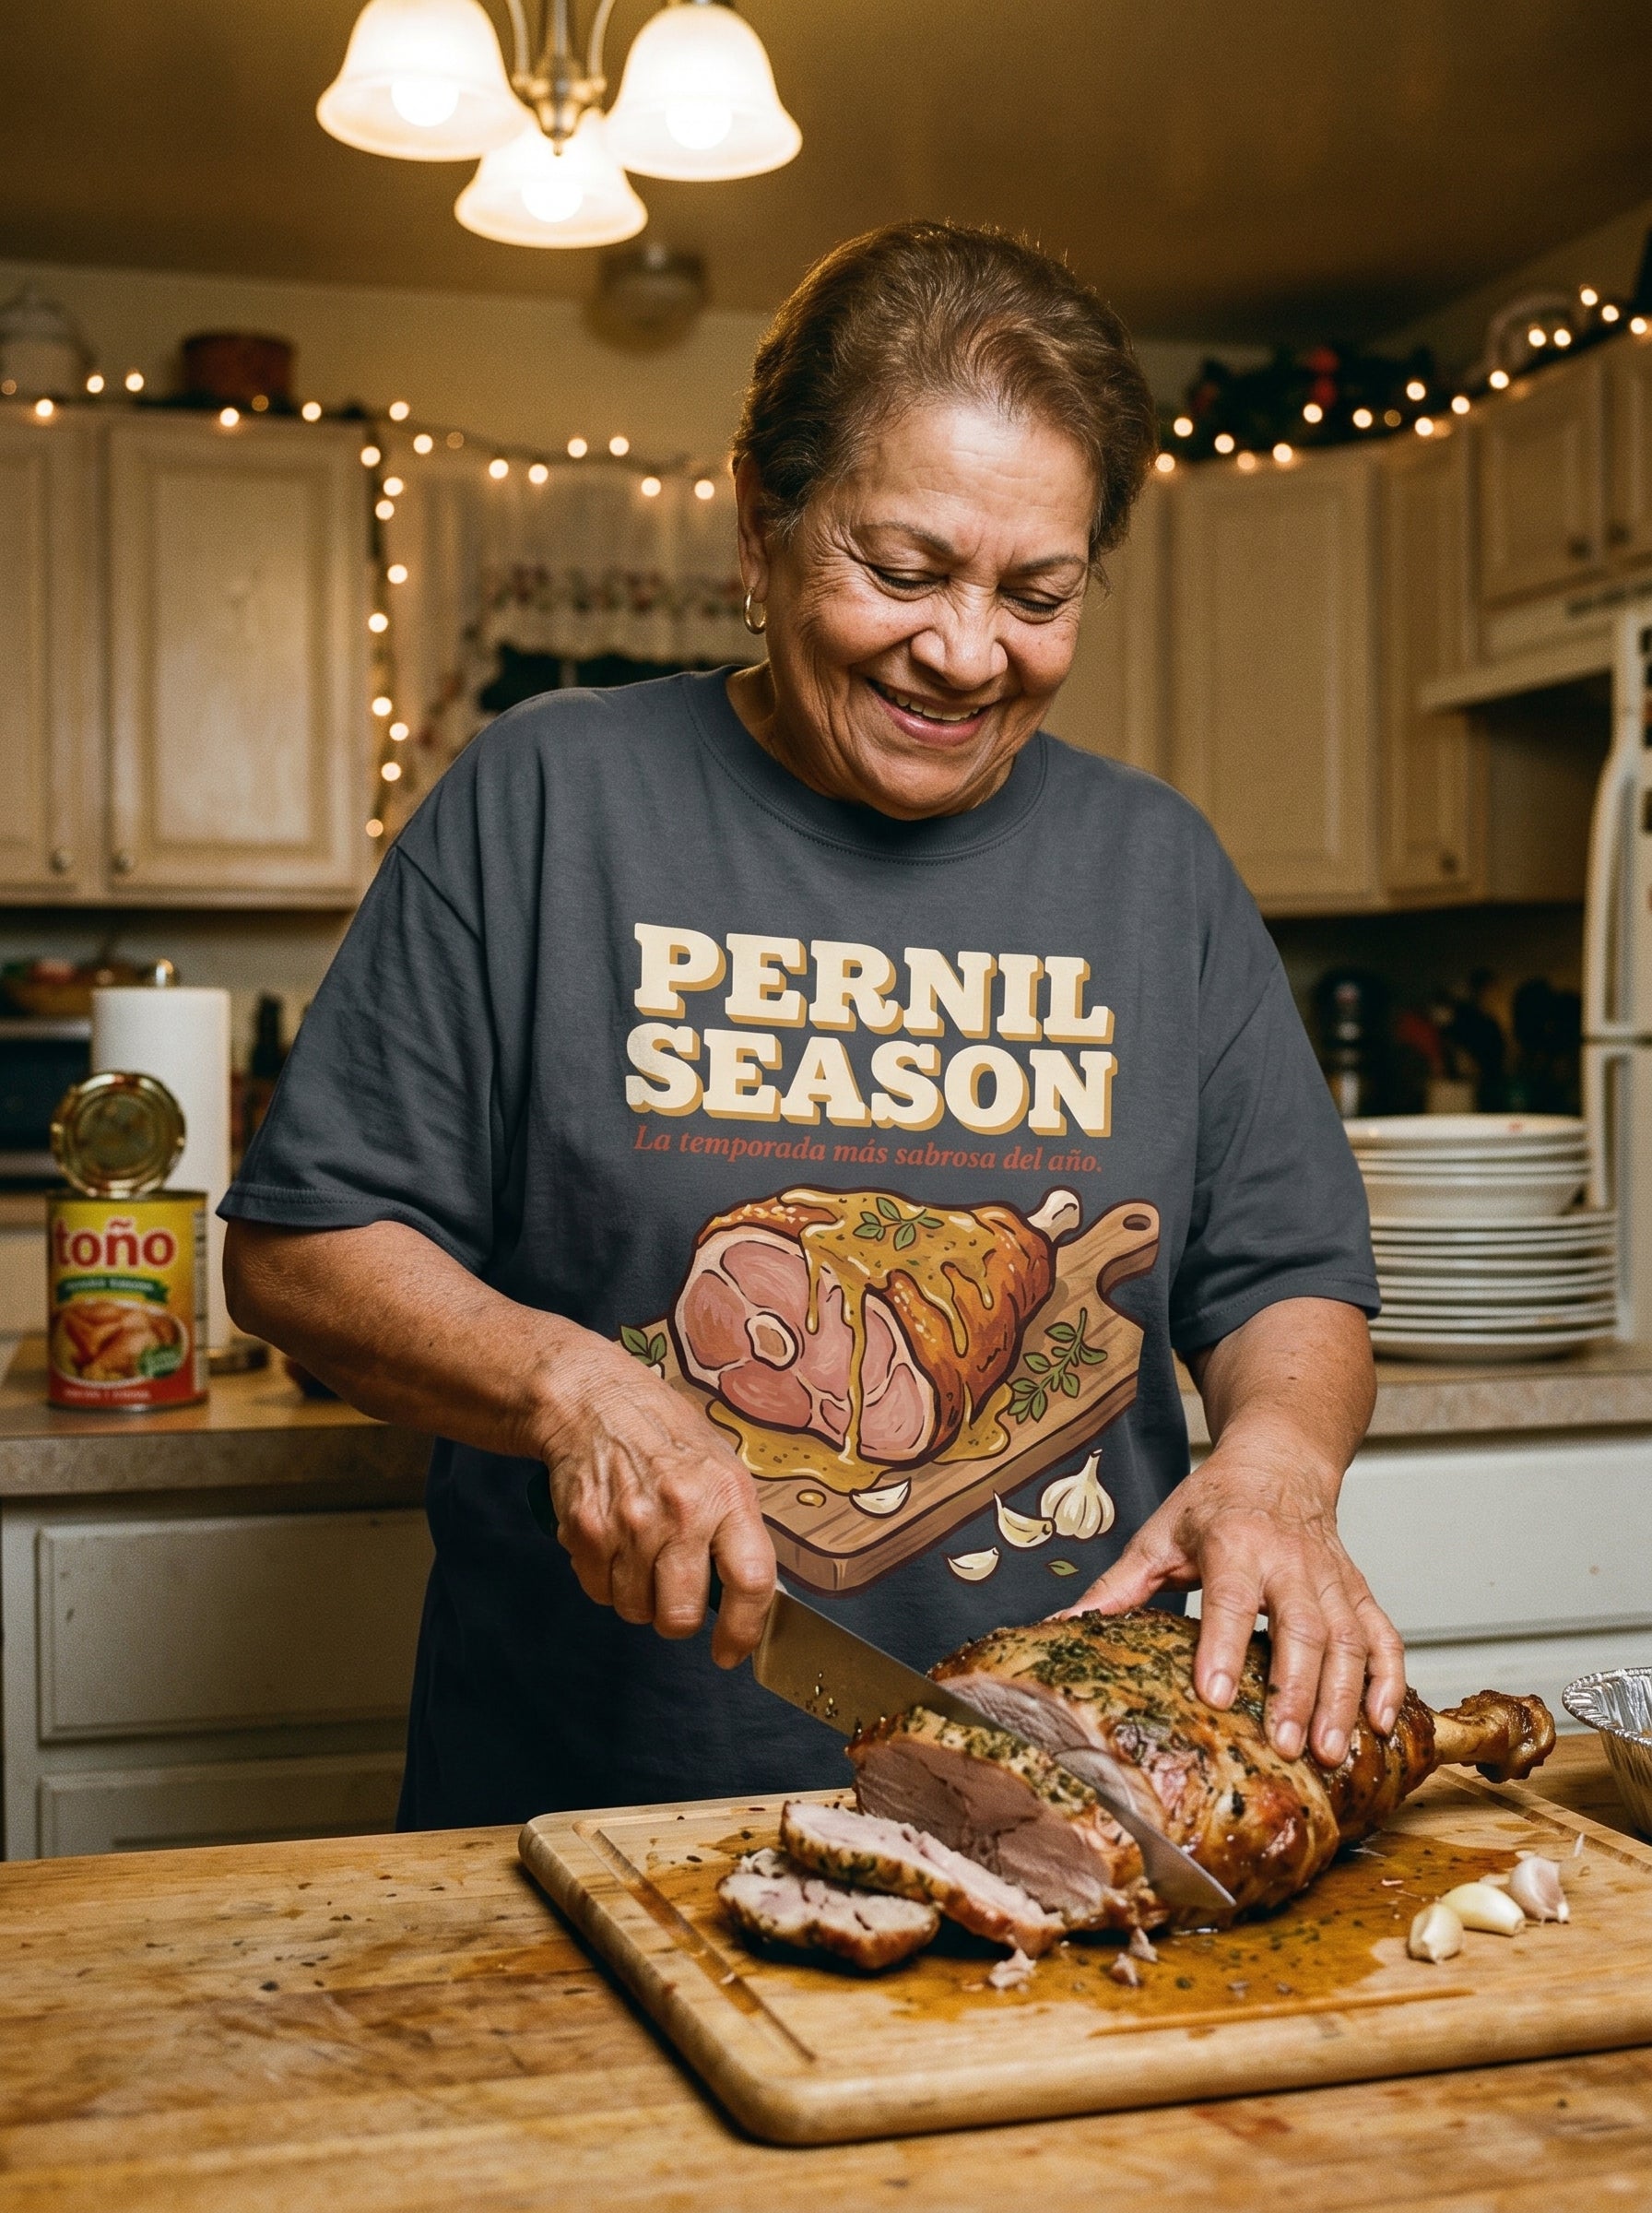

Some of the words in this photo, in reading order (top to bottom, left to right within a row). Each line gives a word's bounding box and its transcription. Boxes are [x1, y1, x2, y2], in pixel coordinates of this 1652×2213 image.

[633, 922, 1115, 1045] PERNIL
[625, 1022, 1118, 1138] SEASON
[634, 1124, 672, 1152] La
[678, 1131, 827, 1163] temporada
[832, 1138, 889, 1165] más
[894, 1142, 996, 1170] sabrosa
[1002, 1145, 1044, 1171] del
[1047, 1148, 1103, 1174] año.
[54, 1218, 176, 1269] toño
